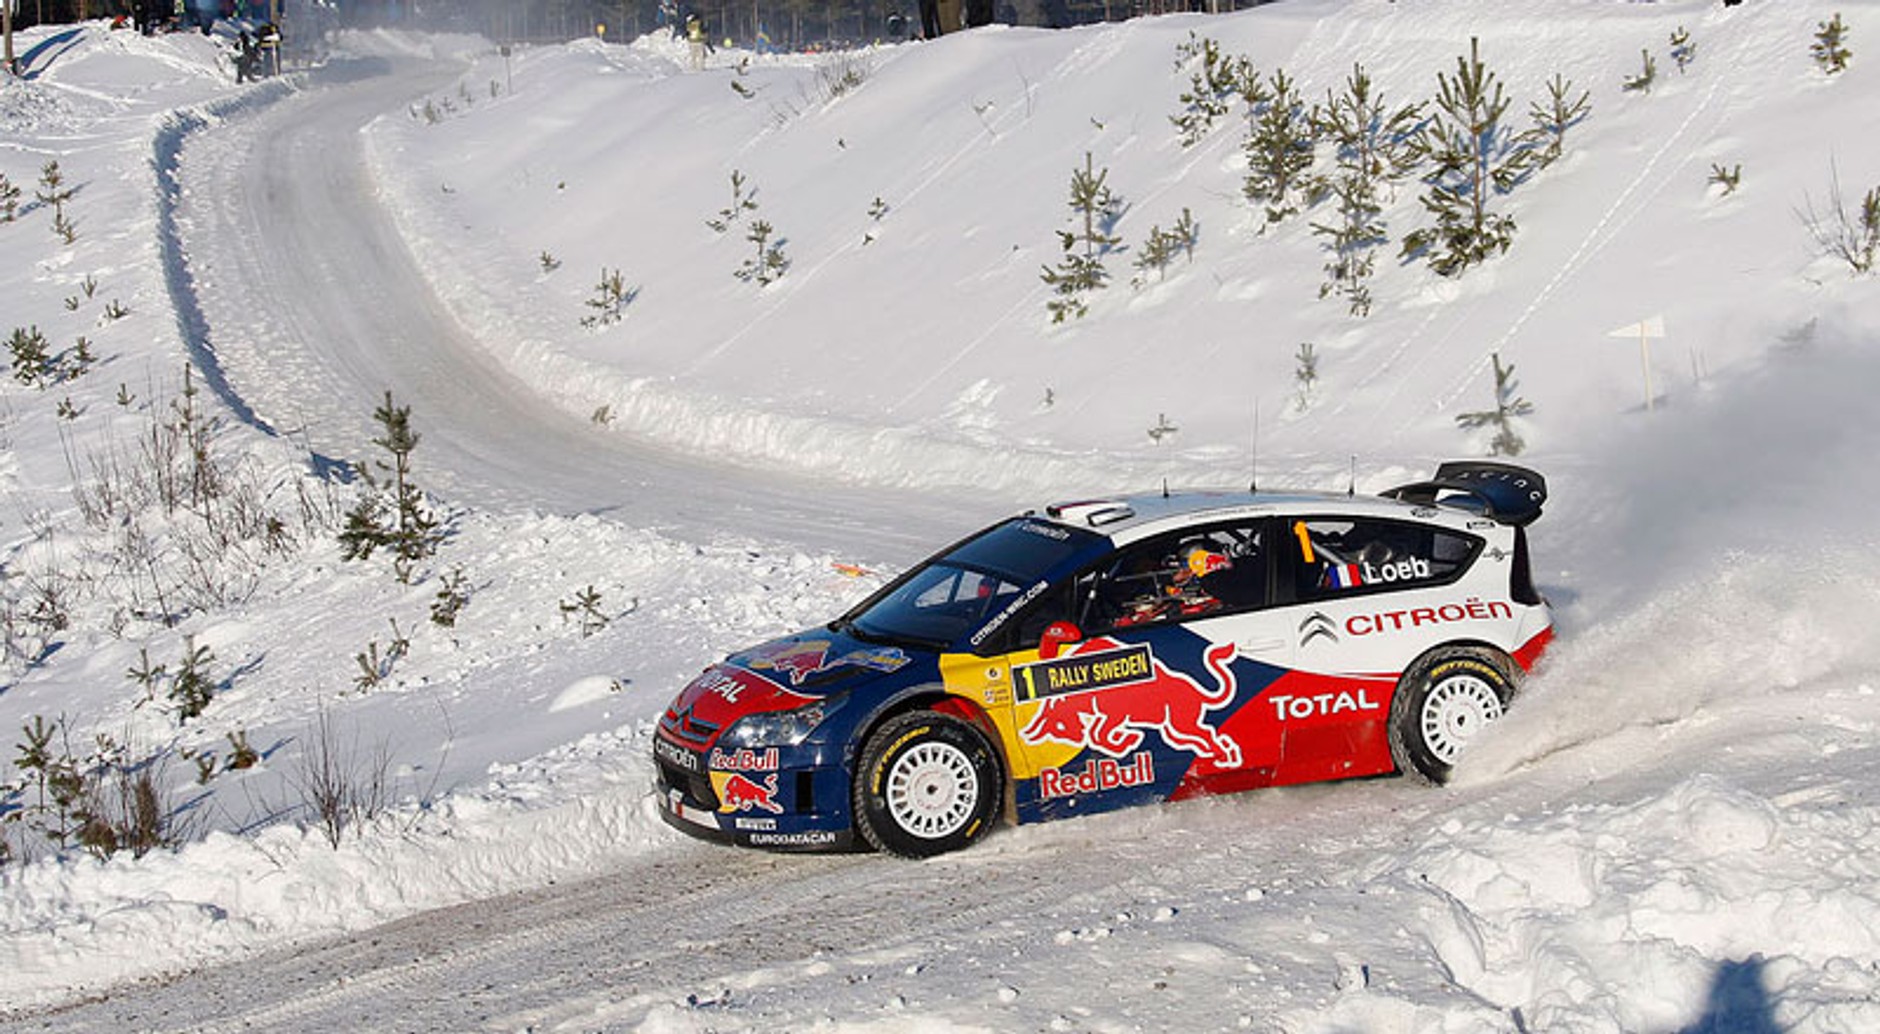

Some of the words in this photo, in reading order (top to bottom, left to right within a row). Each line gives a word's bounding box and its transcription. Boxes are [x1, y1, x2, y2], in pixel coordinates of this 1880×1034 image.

[1294, 521, 1315, 563] 1
[1363, 556, 1429, 583] Loeb
[1022, 666, 1036, 699] 1
[1048, 662, 1089, 689] RALLY
[1093, 652, 1148, 682] SWEDEN
[1269, 689, 1379, 720] TOTAL
[710, 748, 739, 770] Red
[740, 747, 779, 770] Bull
[1041, 760, 1097, 798] Red
[1099, 751, 1154, 789] Bull
[750, 832, 836, 845] EURODATACAR
